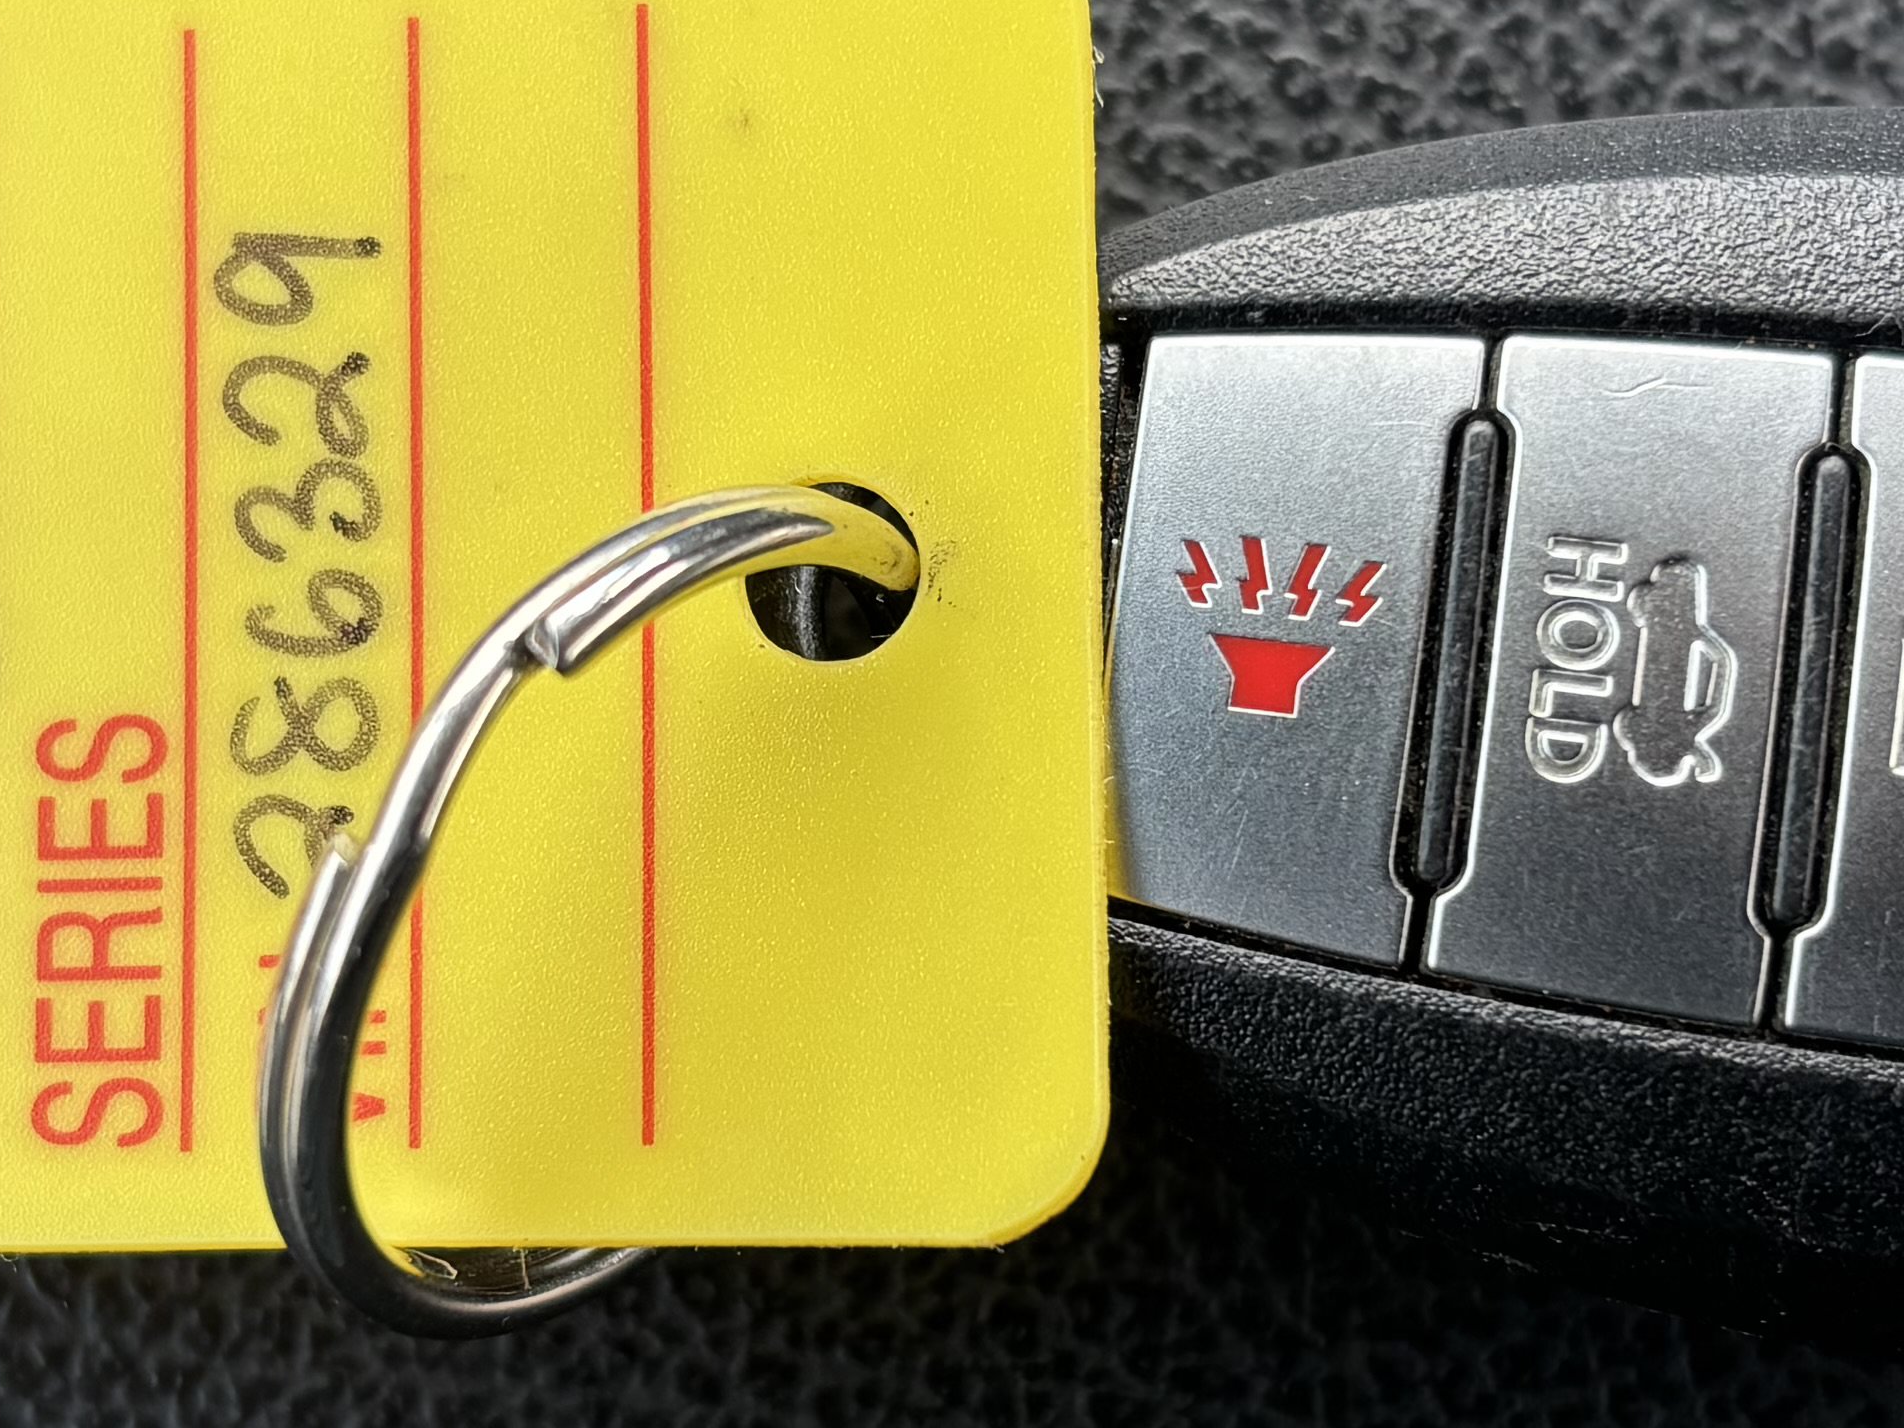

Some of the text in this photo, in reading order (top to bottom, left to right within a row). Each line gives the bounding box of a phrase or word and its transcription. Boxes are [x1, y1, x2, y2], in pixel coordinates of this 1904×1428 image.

[212, 232, 383, 900] 286329
[1522, 536, 1629, 785] HOLD
[30, 712, 168, 1150] SERIES
